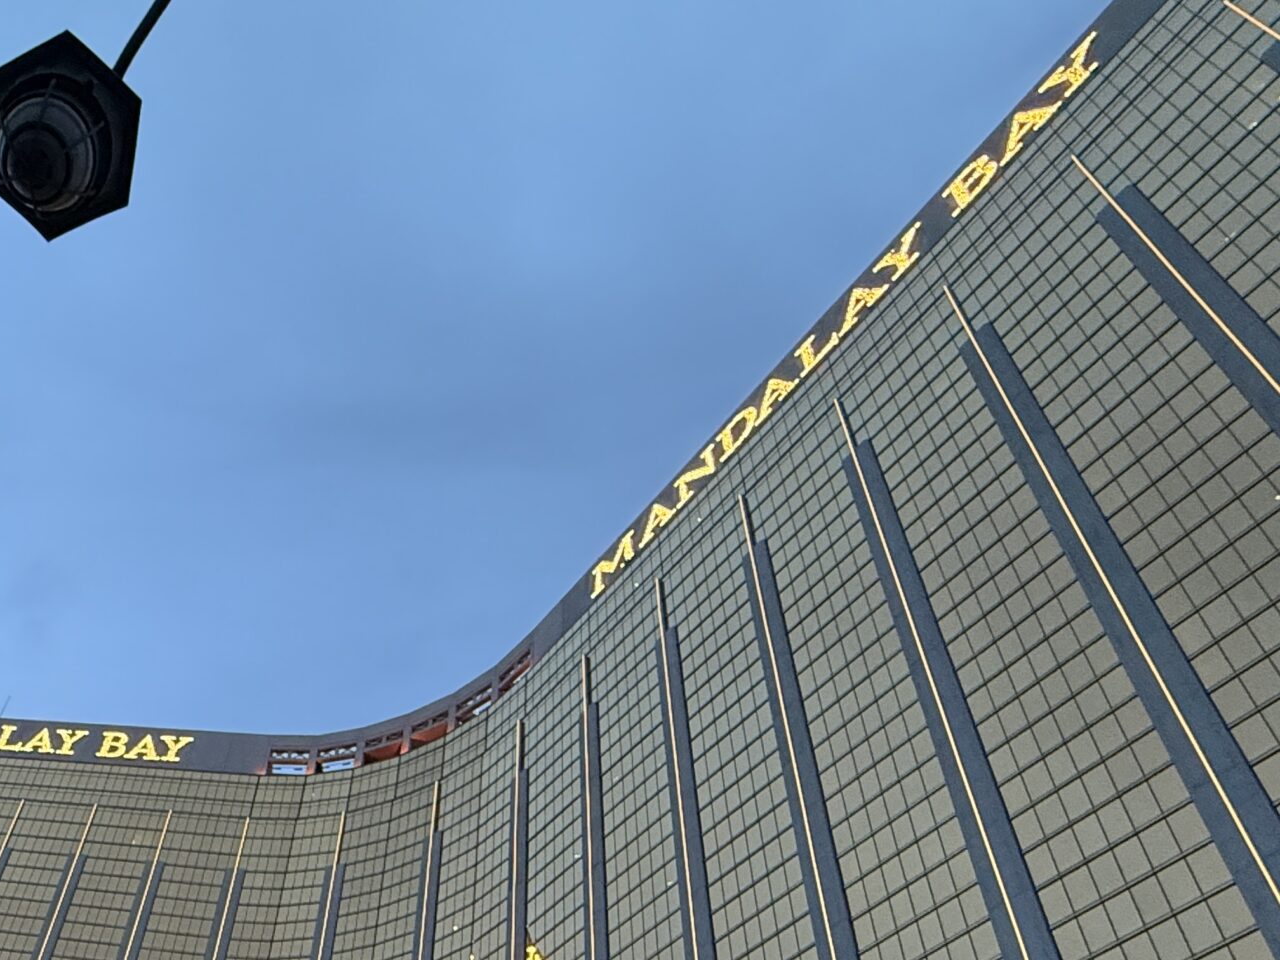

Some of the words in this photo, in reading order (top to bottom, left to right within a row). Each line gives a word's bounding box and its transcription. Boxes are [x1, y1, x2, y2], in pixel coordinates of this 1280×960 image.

[591, 222, 921, 599] MANDALAY
[942, 31, 1098, 217] BAY
[95, 730, 195, 763] BAY
